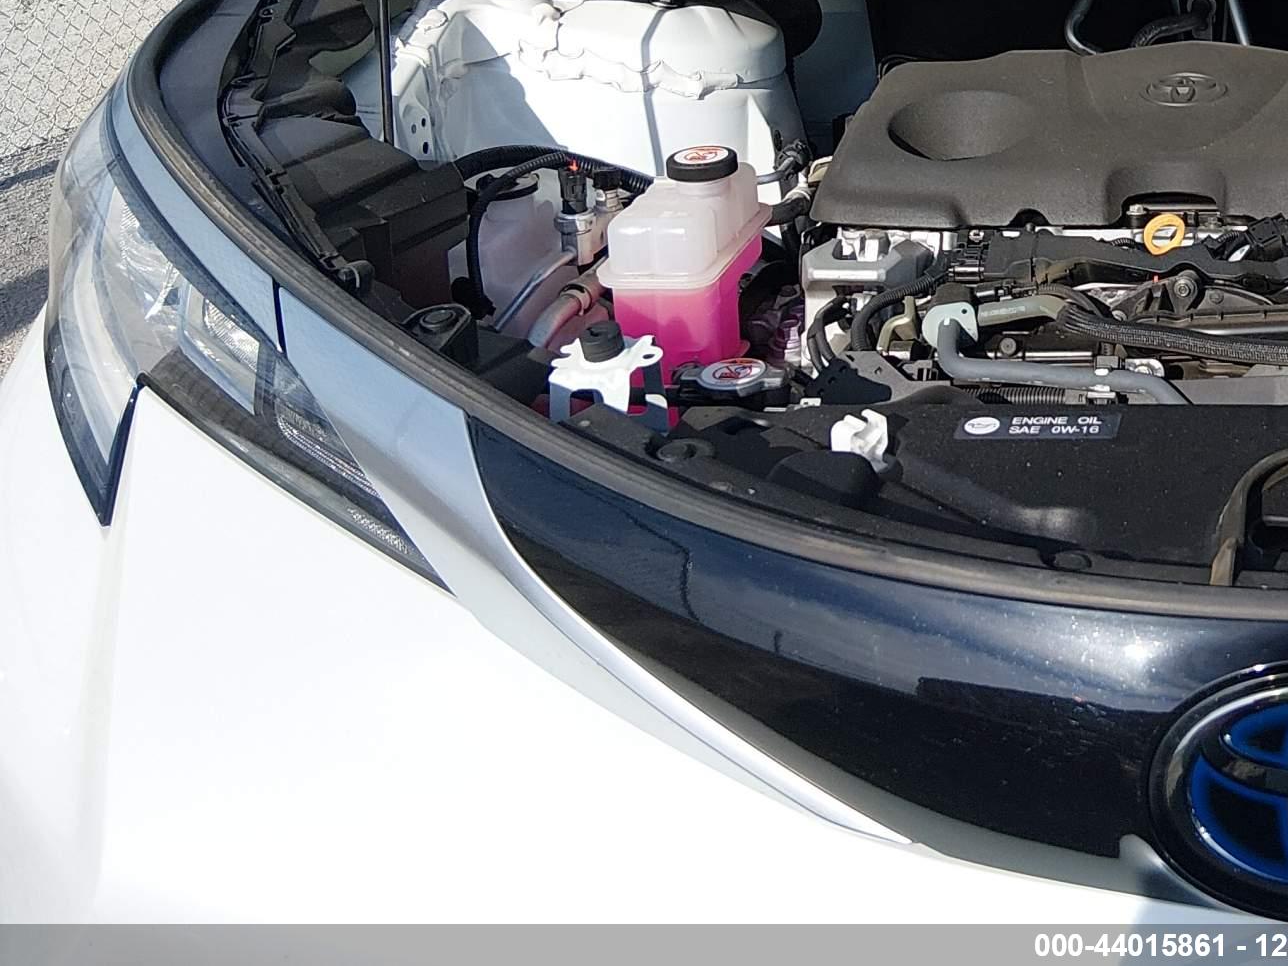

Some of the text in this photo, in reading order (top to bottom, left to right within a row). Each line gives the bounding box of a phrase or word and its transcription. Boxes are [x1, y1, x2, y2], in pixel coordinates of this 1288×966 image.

[1011, 416, 1103, 425] ENGINE OIL
[1008, 425, 1041, 435] SAE
